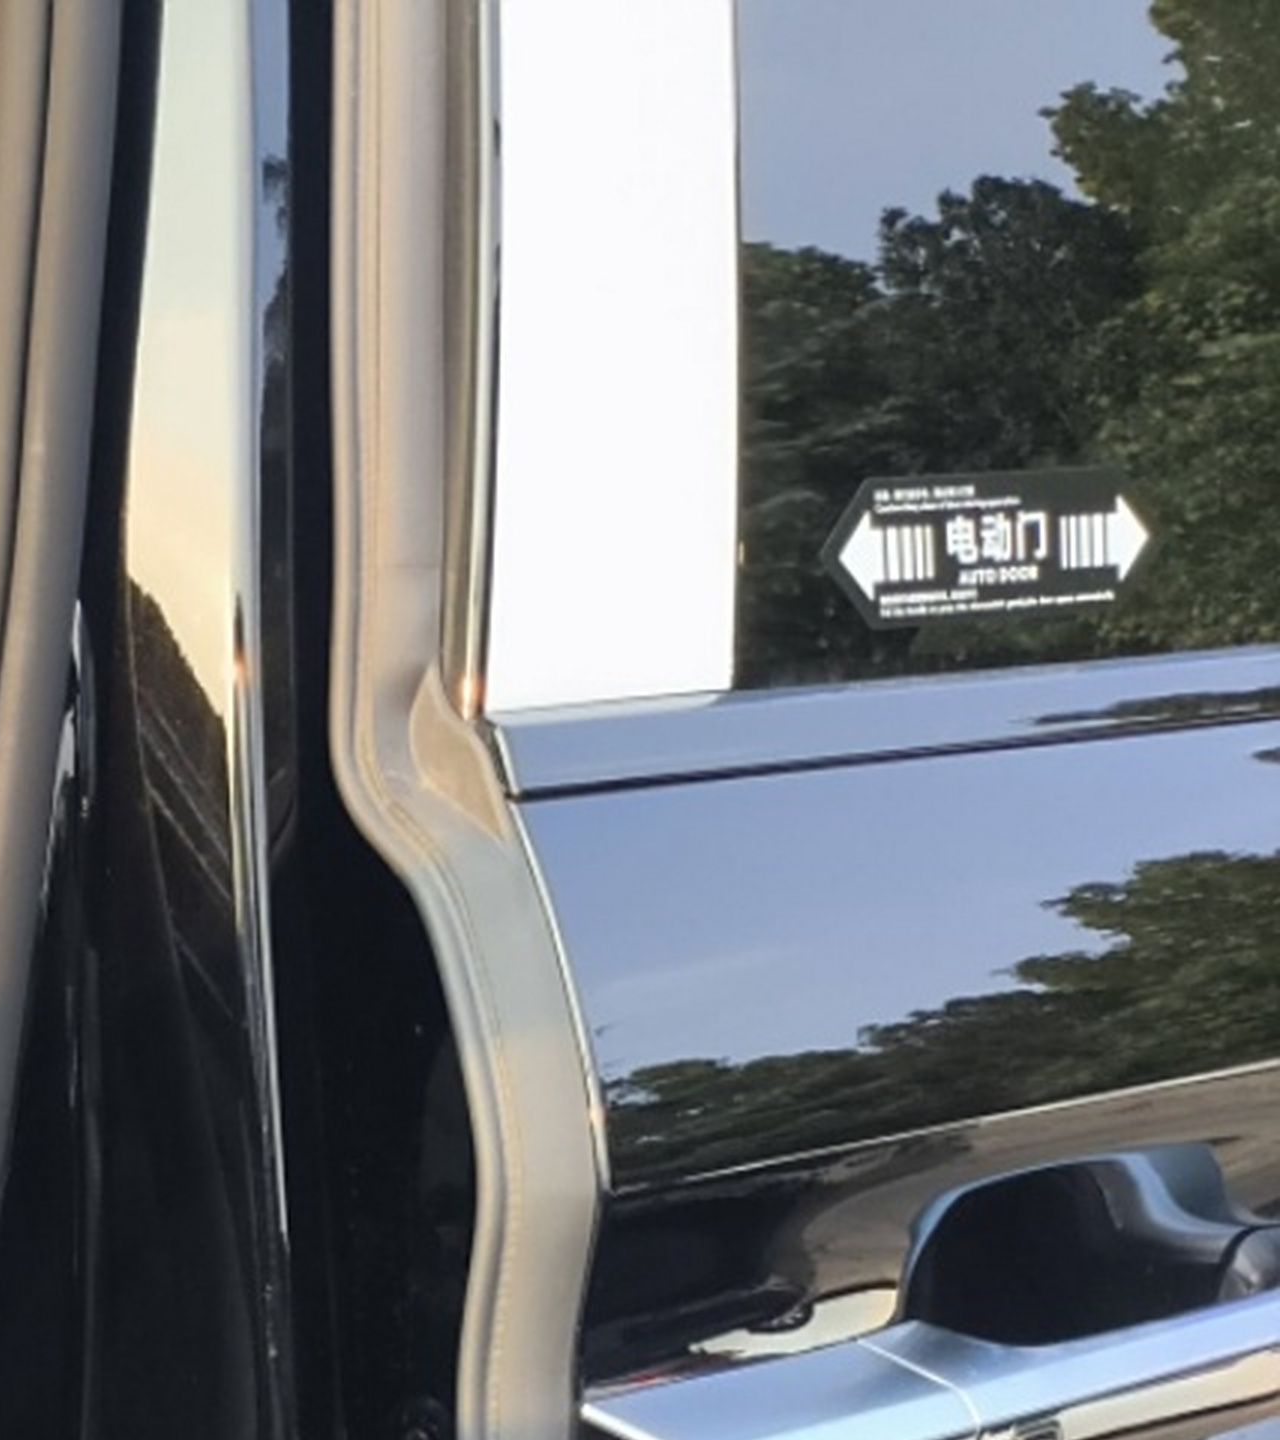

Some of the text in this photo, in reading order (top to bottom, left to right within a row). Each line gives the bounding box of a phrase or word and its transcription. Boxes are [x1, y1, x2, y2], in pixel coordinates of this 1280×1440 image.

[946, 511, 1047, 564] 电动门
[958, 564, 1039, 586] AUTO DOOR
